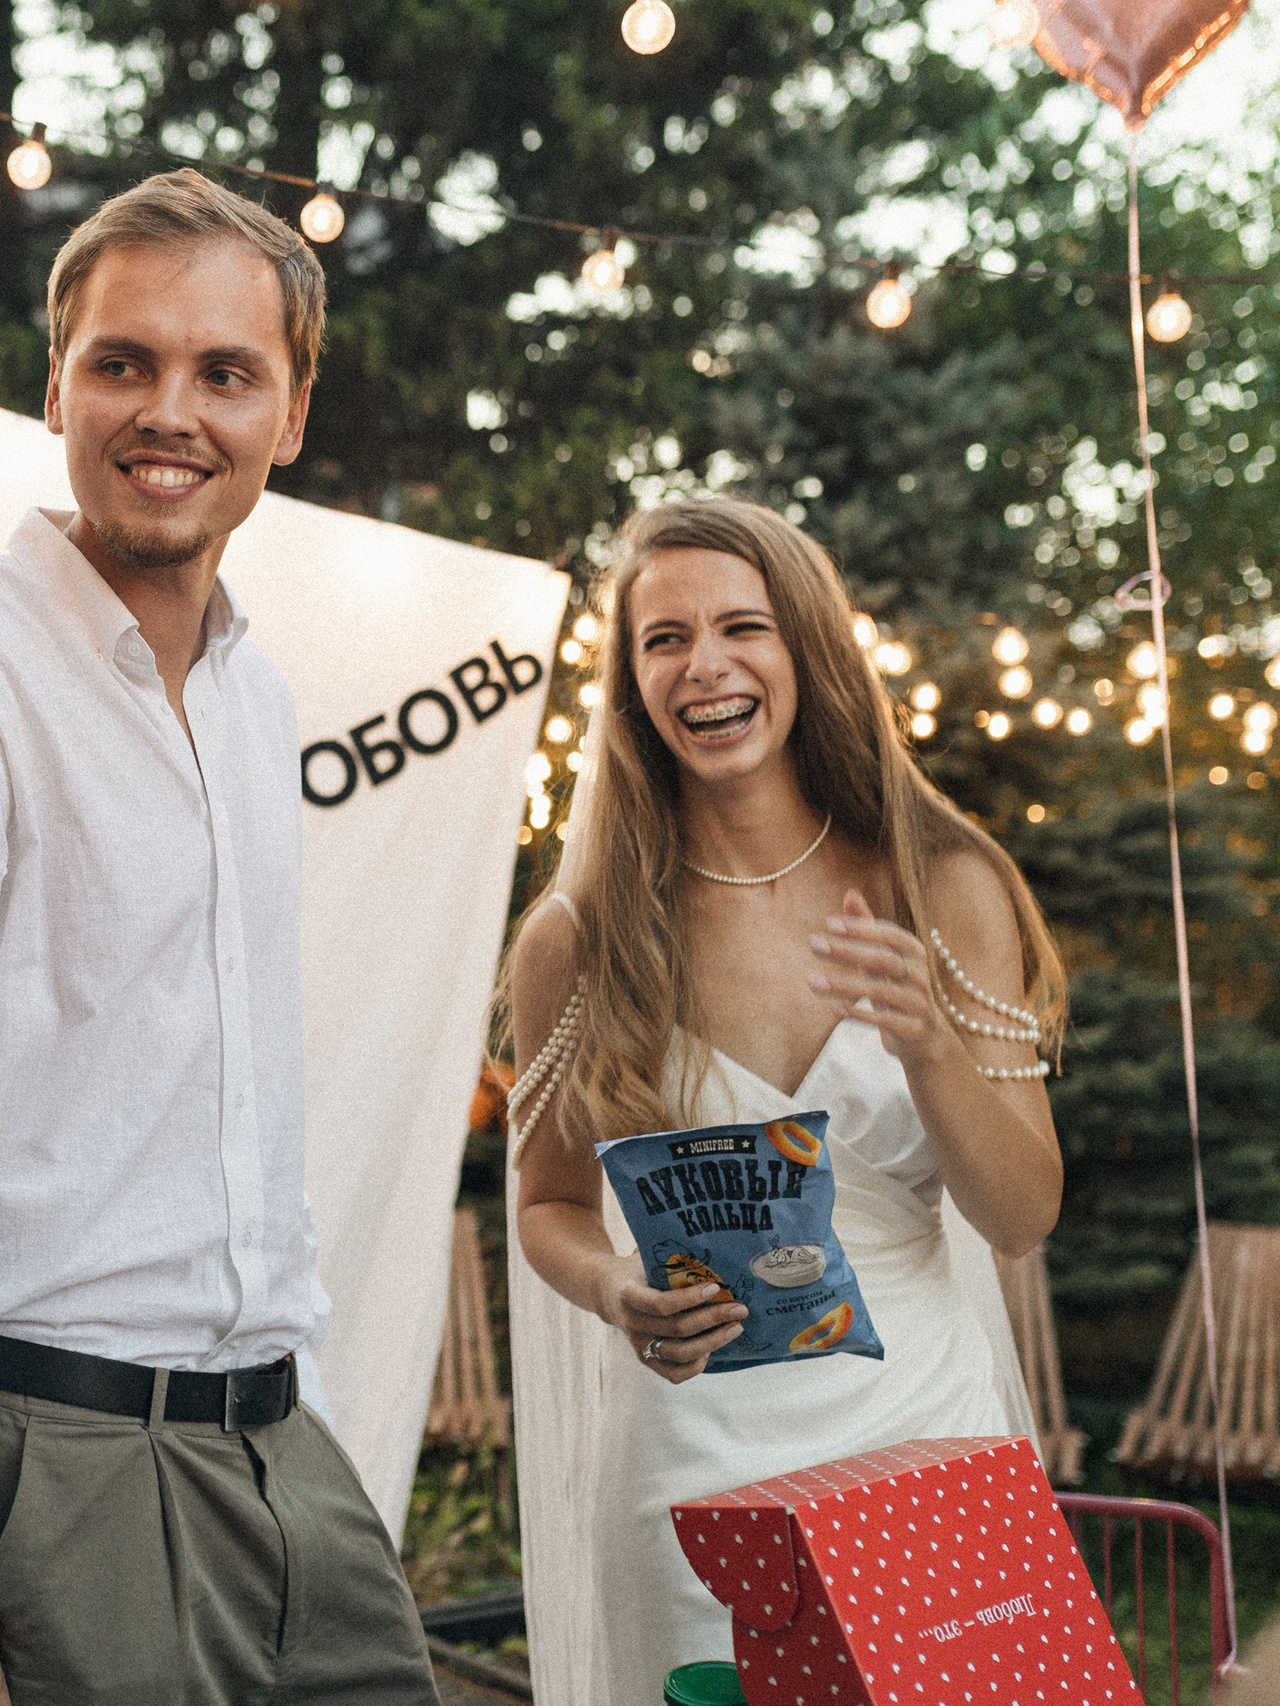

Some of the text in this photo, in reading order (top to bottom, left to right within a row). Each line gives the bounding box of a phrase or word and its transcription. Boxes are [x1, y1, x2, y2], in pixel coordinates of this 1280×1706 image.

[689, 1138, 735, 1154] MINIFREE
[636, 1159, 807, 1216] ЛУКОВЫЕ
[676, 1202, 774, 1237] КОЛЬЦА
[975, 1593, 1037, 1626] Любовь
